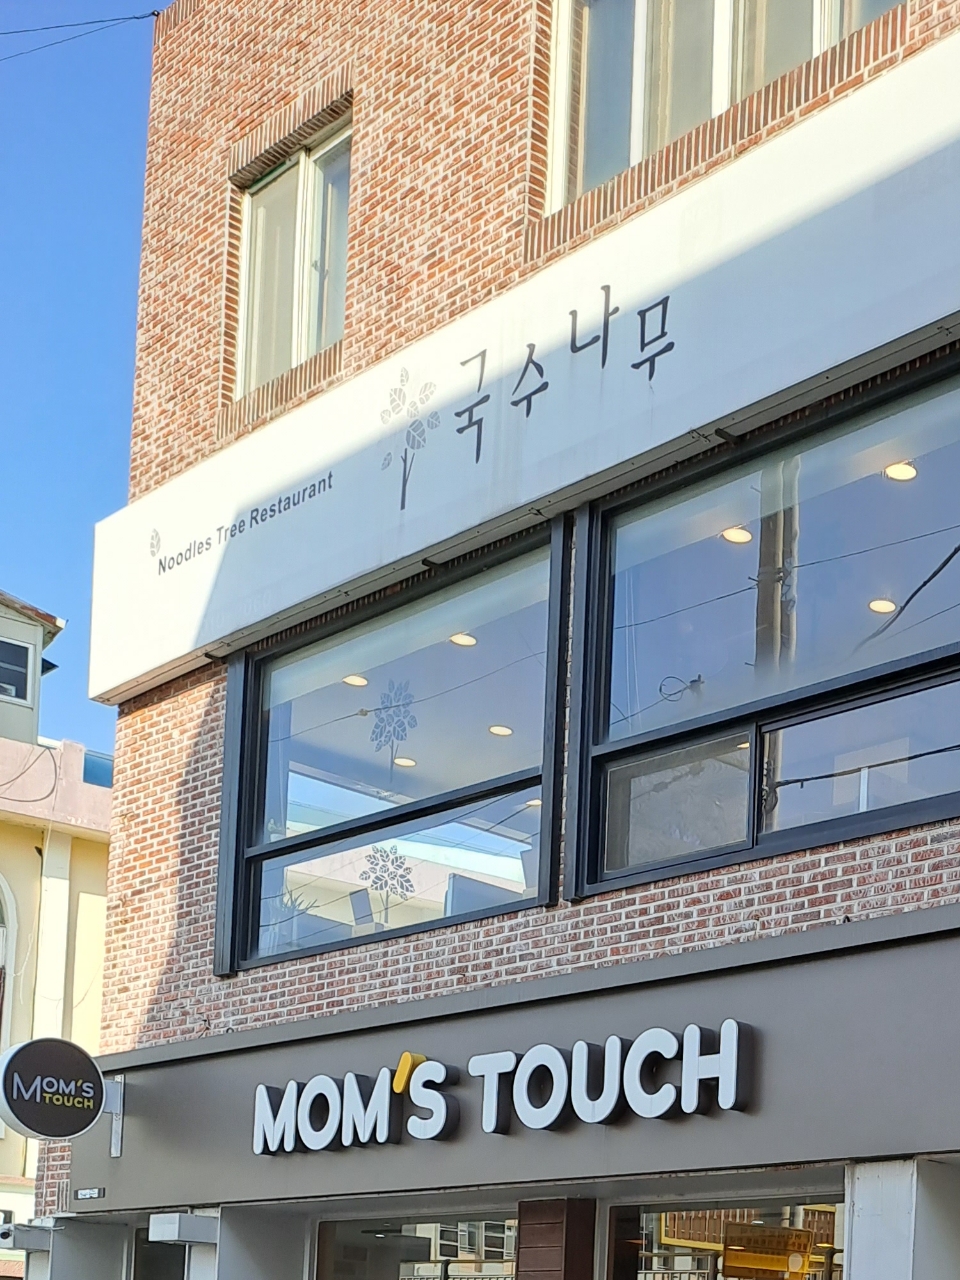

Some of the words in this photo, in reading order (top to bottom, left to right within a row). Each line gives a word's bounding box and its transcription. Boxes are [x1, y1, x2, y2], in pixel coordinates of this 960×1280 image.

[454, 284, 675, 464] 국수나무
[157, 533, 213, 577] Noodles
[216, 513, 246, 547] Tree
[248, 470, 334, 530] Restaurant
[12, 1071, 95, 1103] MOM'S
[42, 1093, 94, 1109] TOUCH
[252, 1051, 452, 1156] MOM'S
[468, 1018, 745, 1134] TOUCH
